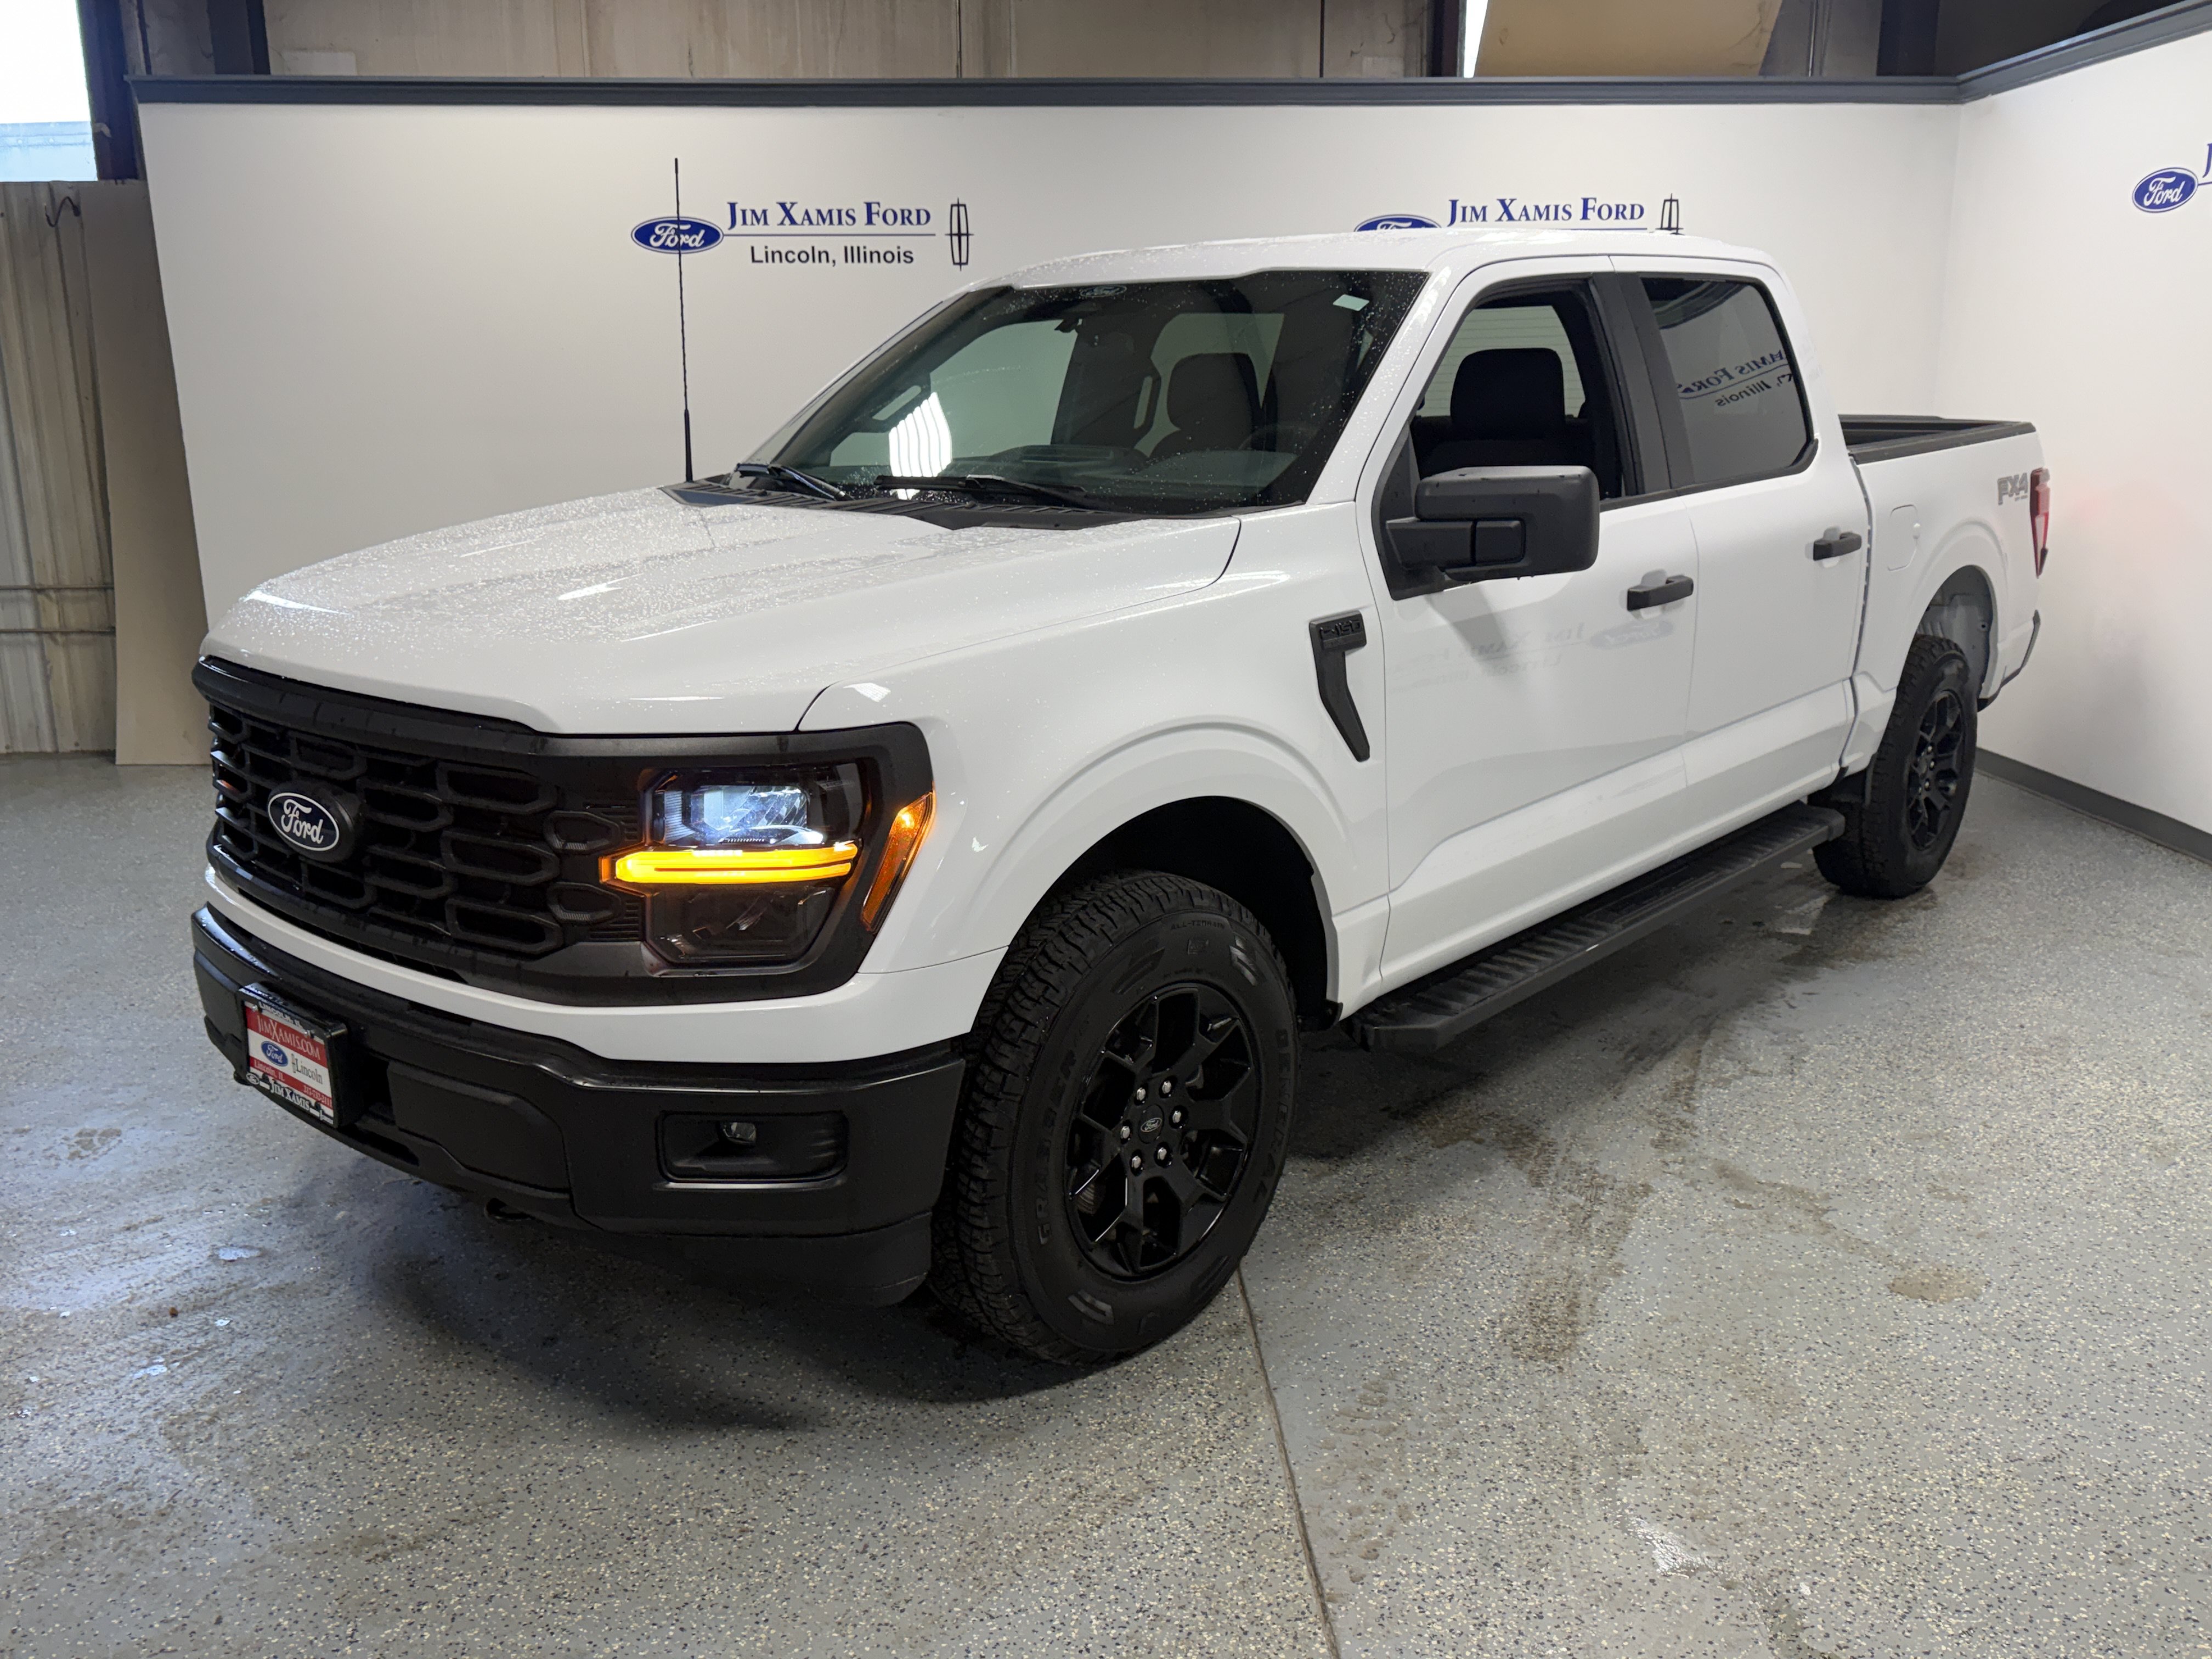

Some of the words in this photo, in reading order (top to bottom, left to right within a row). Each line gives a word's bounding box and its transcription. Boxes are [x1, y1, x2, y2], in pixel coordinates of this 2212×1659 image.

[2143, 176, 2186, 207] Ford
[727, 202, 769, 230] JIM
[776, 201, 856, 227] XAMIS
[864, 201, 931, 227] FORD
[1447, 199, 1487, 227] JIM
[1496, 198, 1573, 222] XAMIS
[1581, 197, 1645, 221] FORD
[650, 223, 705, 249] Ford
[751, 246, 836, 267] Lincoln,
[844, 246, 914, 264] Illinois
[1997, 472, 2028, 506] FX4
[281, 798, 324, 844] Ford
[257, 1014, 320, 1060] JIMXAMIS.COM
[266, 1044, 283, 1063] Ford
[296, 1058, 323, 1085] Lincoln
[270, 1080, 284, 1098] JIM
[285, 1089, 310, 1111] XAMIS
